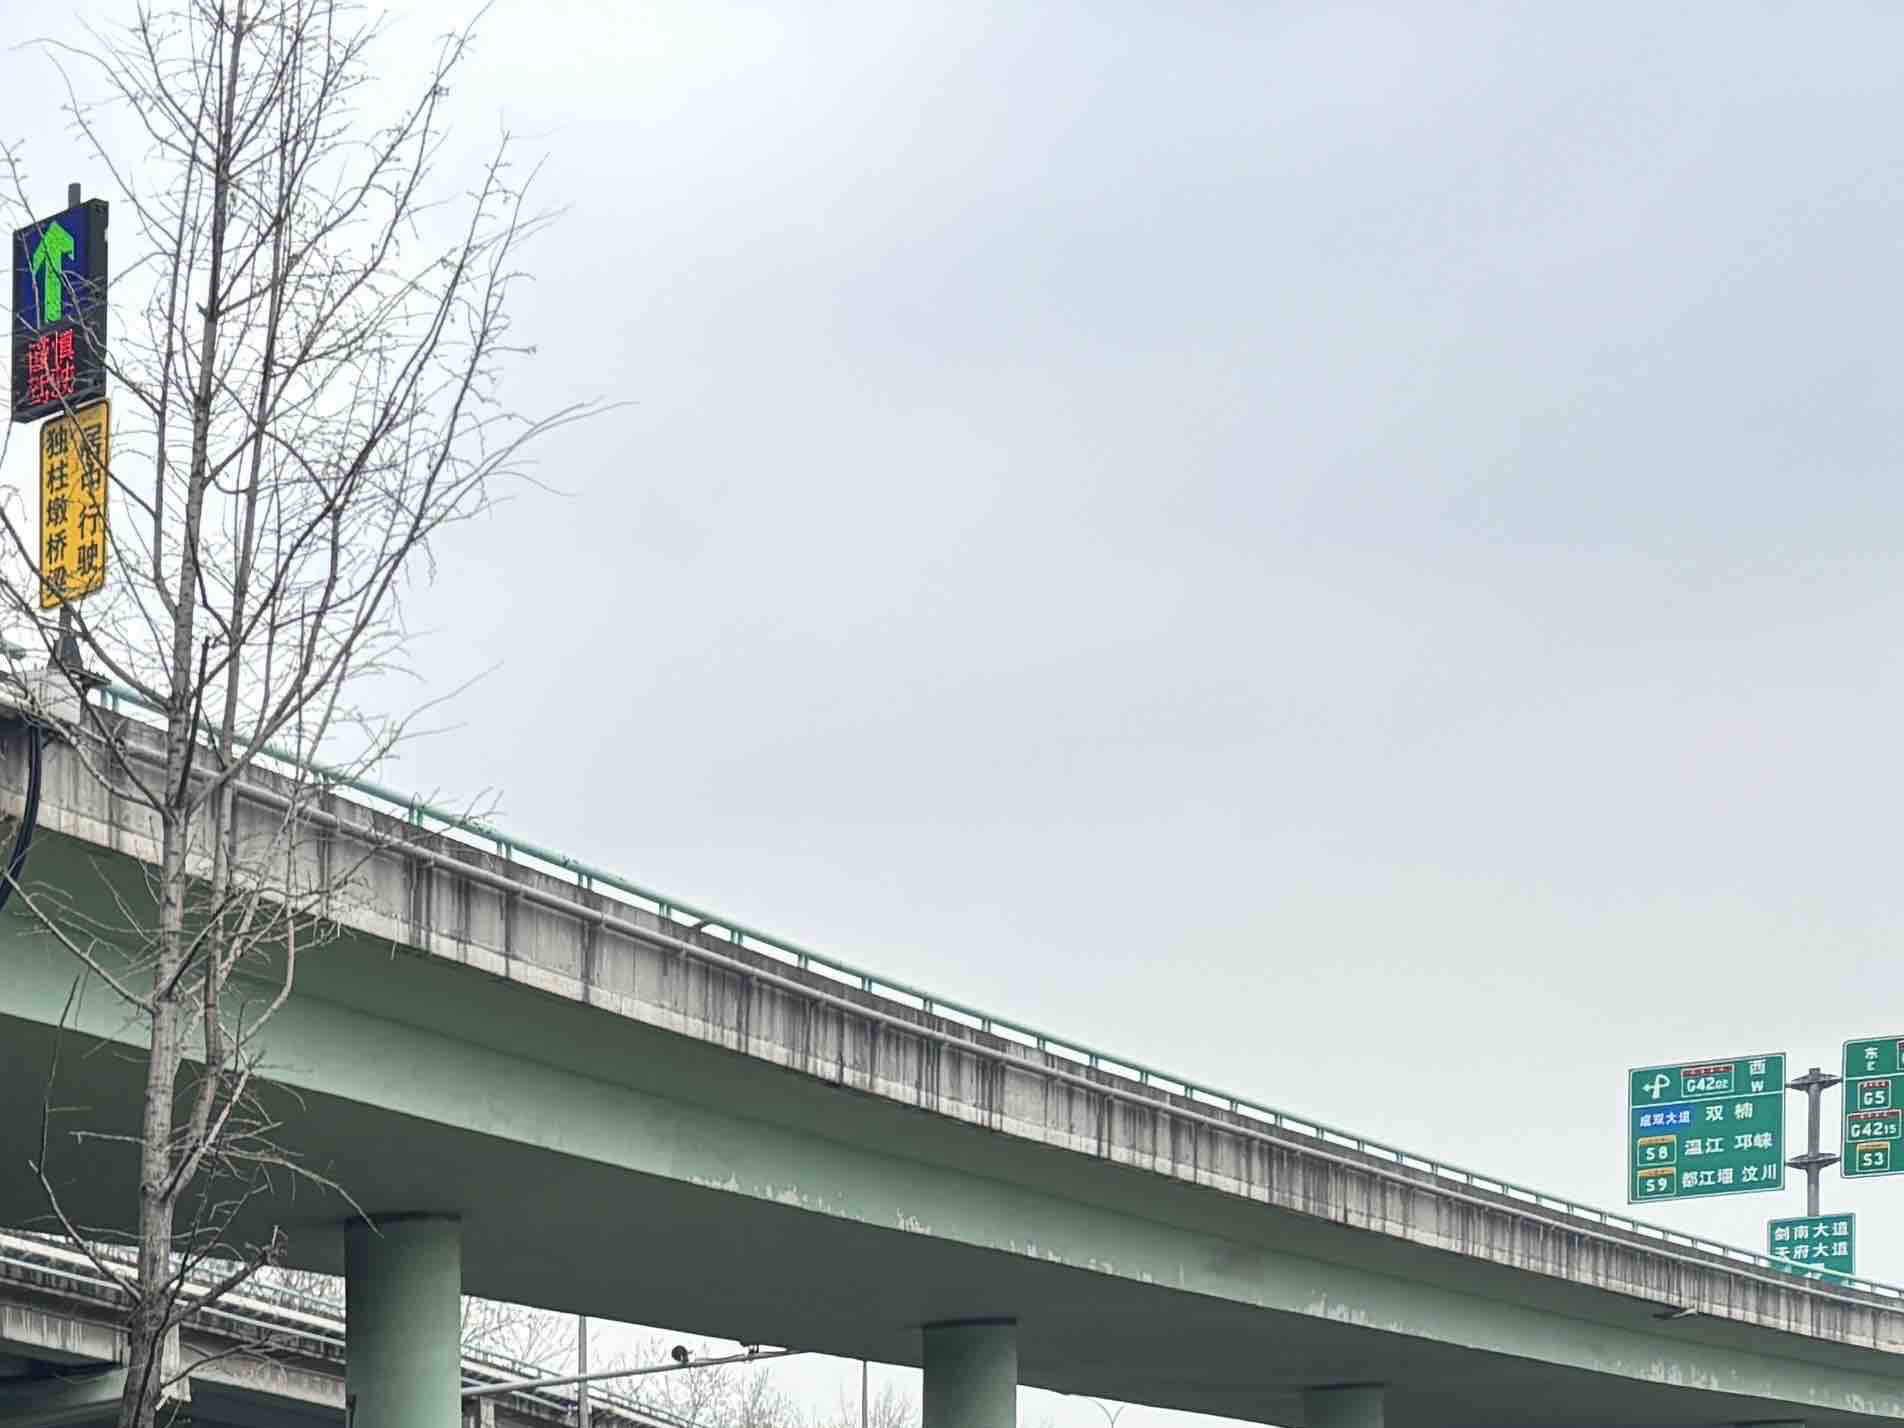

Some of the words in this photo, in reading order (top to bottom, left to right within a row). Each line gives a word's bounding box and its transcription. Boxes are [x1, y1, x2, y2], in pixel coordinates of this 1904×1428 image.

[78, 423, 102, 577] 居中行驶
[1864, 1046, 1879, 1060] 东
[1748, 1058, 1766, 1075] 西
[1751, 1080, 1764, 1093] W
[1863, 1090, 1885, 1106] G5
[1850, 1122, 1897, 1138] G4215
[1646, 1147, 1669, 1161] S8
[1684, 1137, 1725, 1156] 温江
[1863, 1152, 1884, 1167] S3
[1682, 1168, 1733, 1188] 都江堰
[1742, 1163, 1777, 1183] 汶川
[1646, 1178, 1668, 1192] S9
[1774, 1221, 1849, 1241] 剑南大道
[1774, 1241, 1849, 1262] 天府大道
